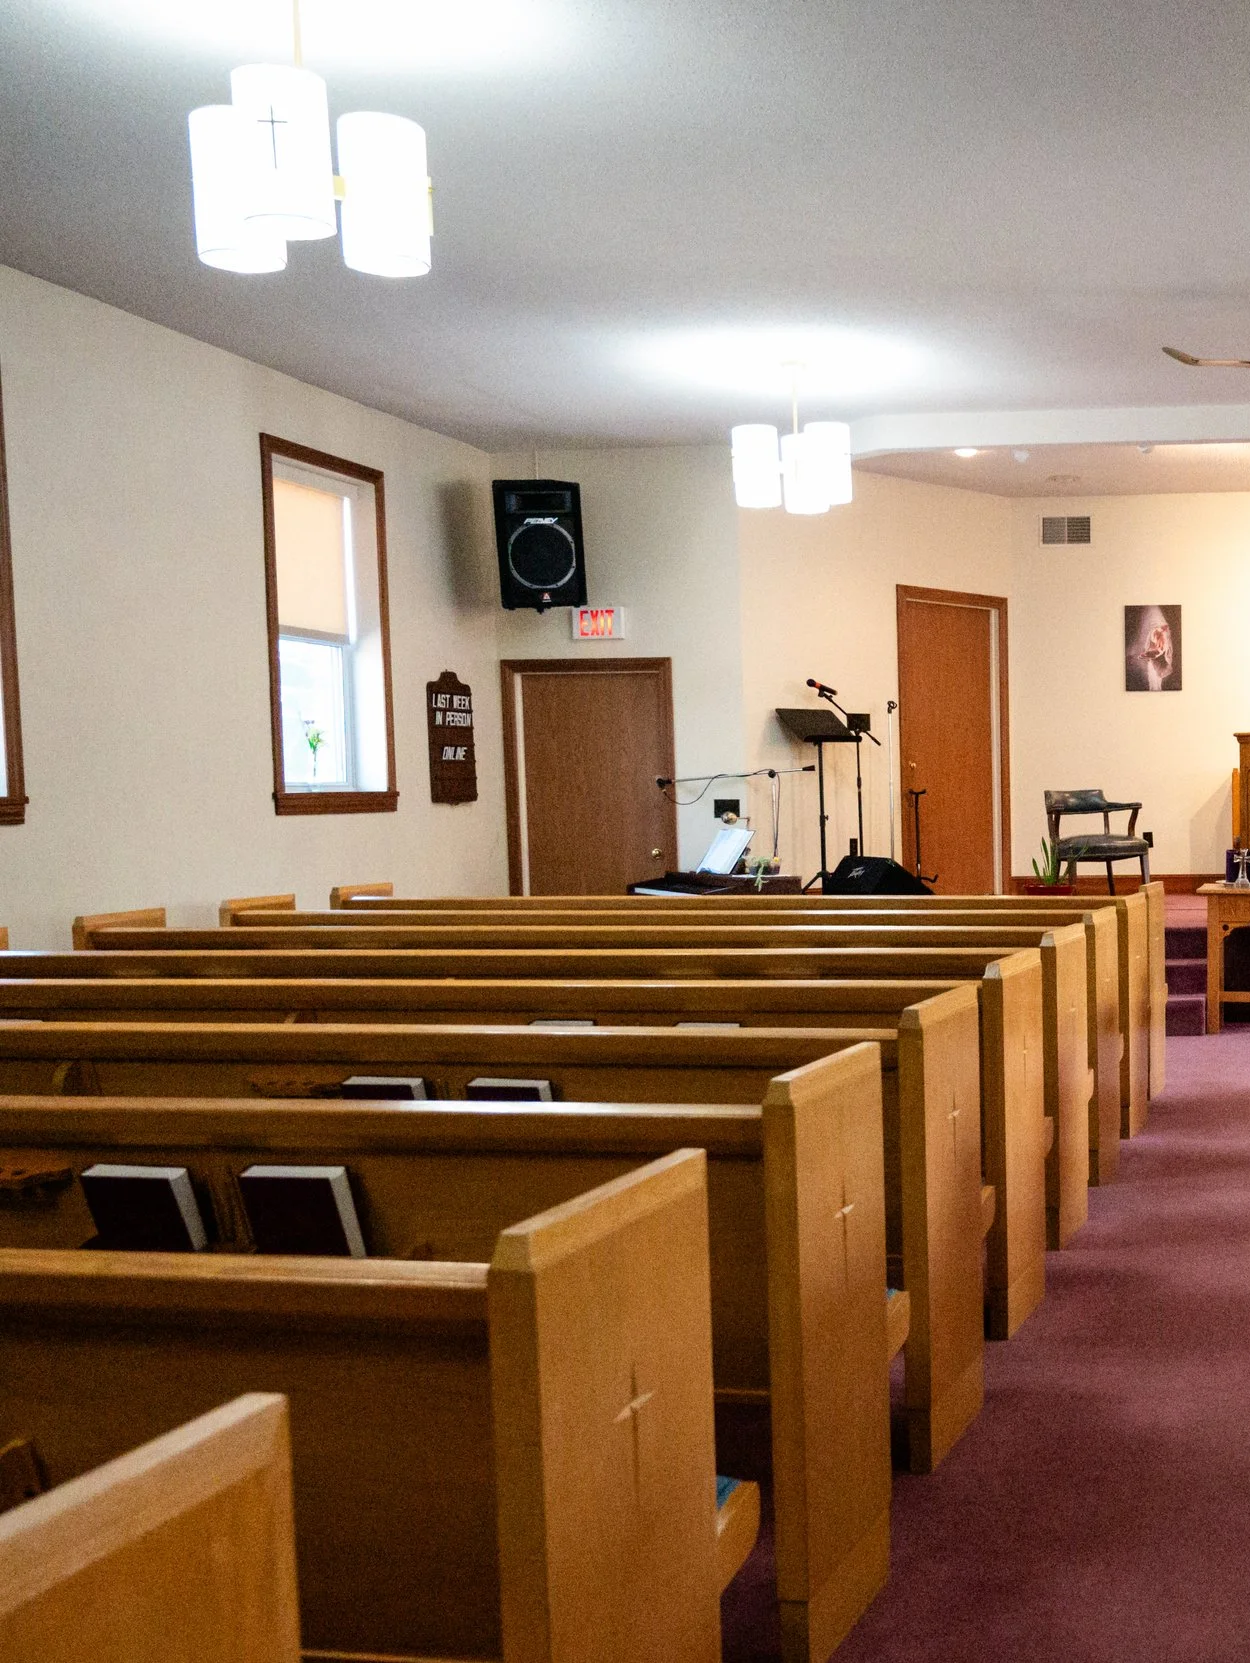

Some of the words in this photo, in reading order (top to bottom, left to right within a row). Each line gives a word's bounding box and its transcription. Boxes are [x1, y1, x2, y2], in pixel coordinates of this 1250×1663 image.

[579, 609, 615, 636] EXIT
[432, 693, 451, 708] LAST
[452, 695, 471, 710] WEEK
[435, 711, 443, 726] IN
[445, 711, 472, 727] PERSON
[442, 746, 468, 761] ONLINE
